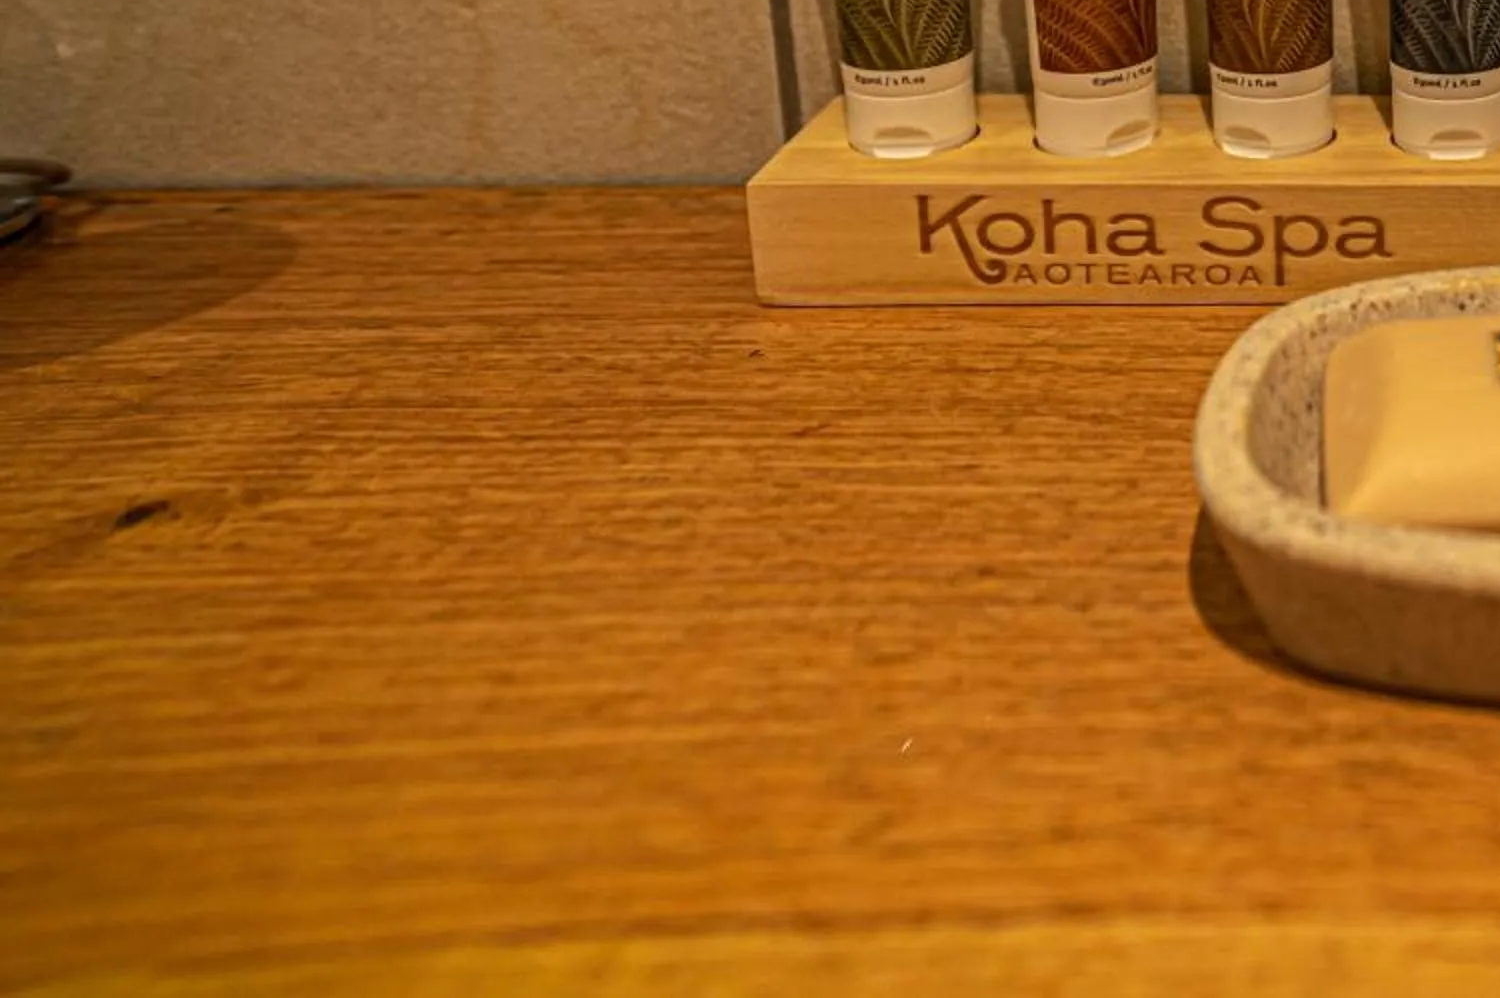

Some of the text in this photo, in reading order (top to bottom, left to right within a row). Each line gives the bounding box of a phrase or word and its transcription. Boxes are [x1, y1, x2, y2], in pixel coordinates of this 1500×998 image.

[913, 193, 1394, 287] Koha Spa
[1012, 262, 1262, 287] AOTEAROA
